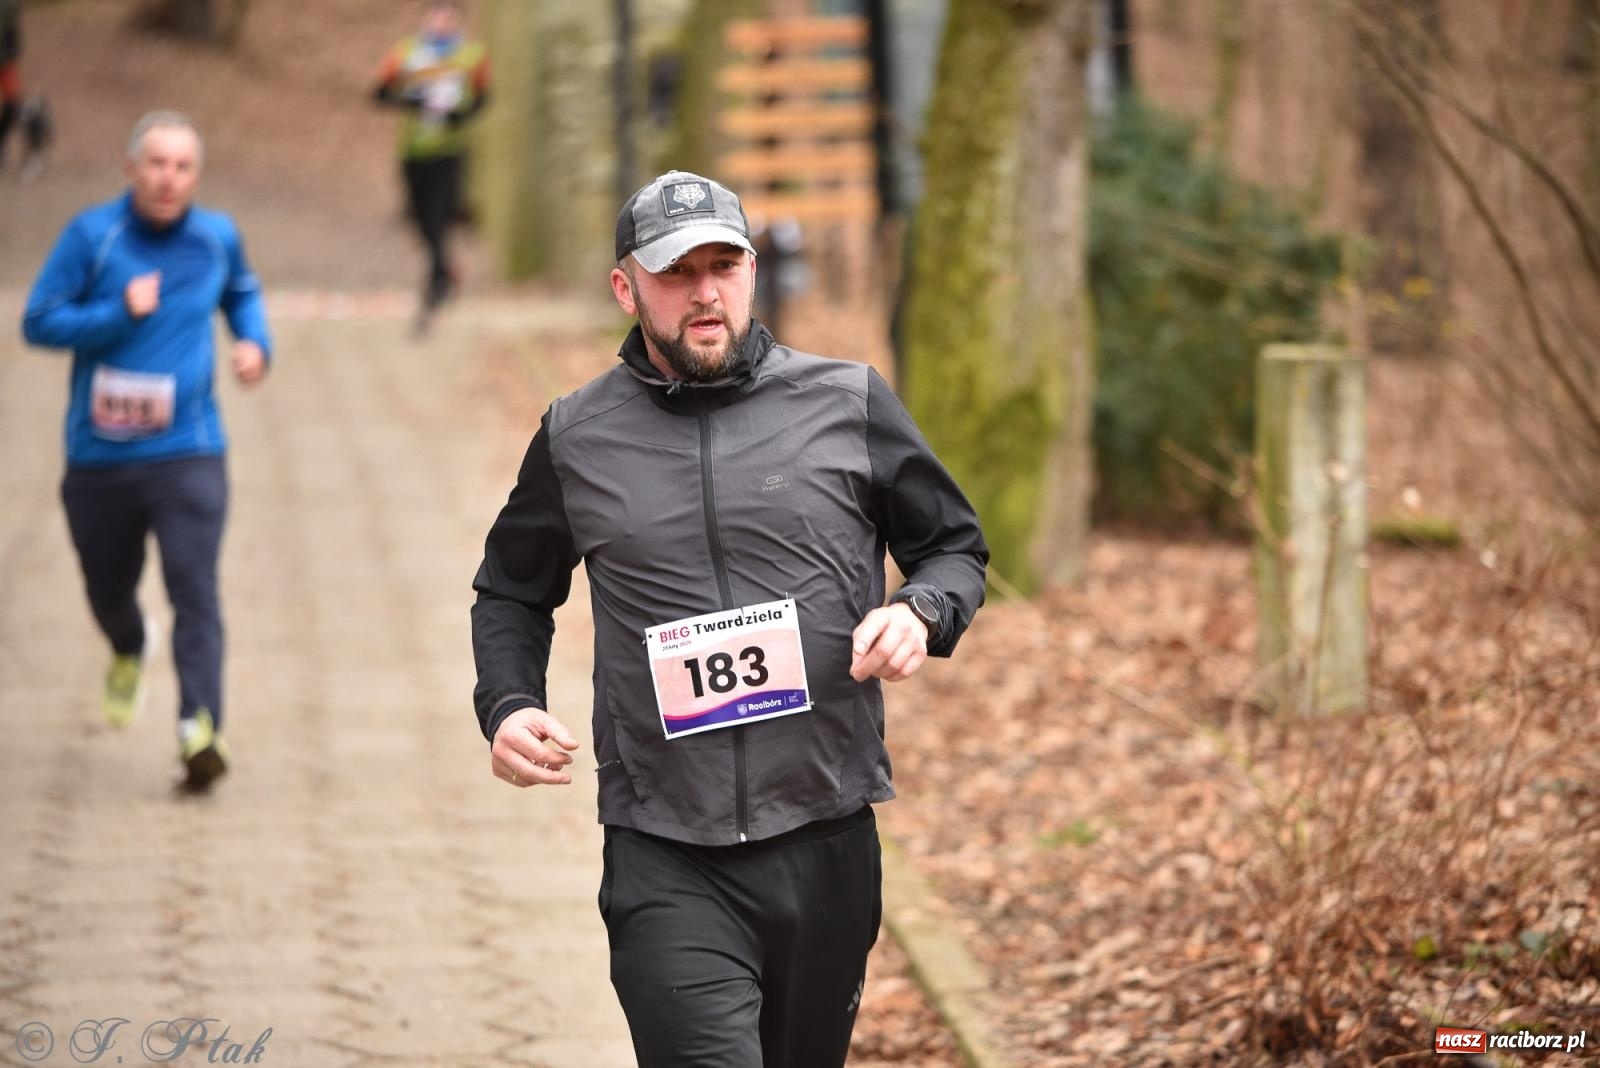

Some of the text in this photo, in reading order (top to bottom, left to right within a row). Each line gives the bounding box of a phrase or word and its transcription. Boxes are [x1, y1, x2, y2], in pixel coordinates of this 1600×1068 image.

[659, 609, 783, 643] BIEG Twardziela
[684, 646, 769, 698] 183
[748, 699, 782, 712] Racibórz
